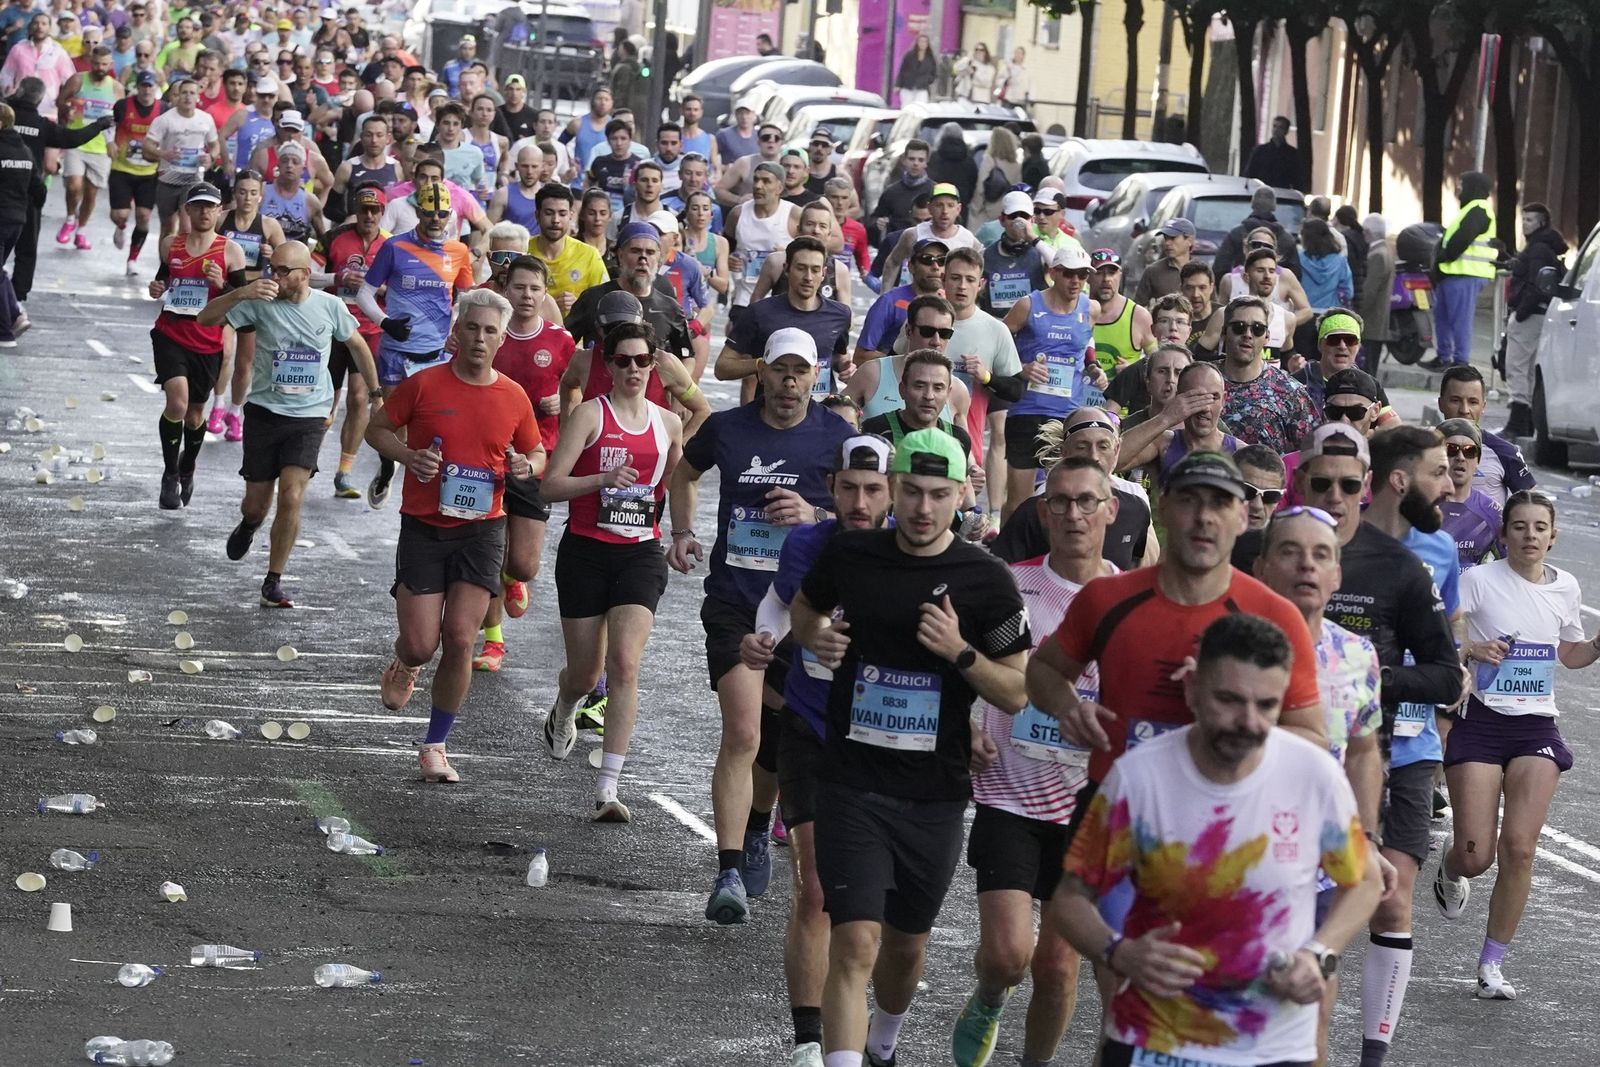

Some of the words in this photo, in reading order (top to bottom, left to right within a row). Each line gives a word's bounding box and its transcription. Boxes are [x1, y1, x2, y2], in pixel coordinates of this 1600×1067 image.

[994, 290, 1028, 300] MOURAD
[170, 297, 203, 306] KRISTOF
[1047, 332, 1072, 340] ITALIA
[1047, 355, 1069, 364] ZURIC
[275, 373, 315, 384] ALBERTO
[600, 446, 628, 458] HYDE
[600, 457, 627, 467] PARK
[461, 468, 490, 480] ZURICH
[738, 475, 798, 486] MICHELIN
[459, 484, 477, 494] 5787
[453, 494, 476, 508] EDD
[621, 501, 639, 510] 4966
[610, 510, 646, 525] HONOR
[750, 528, 770, 539] 6939
[727, 543, 759, 556] SIEMPRE
[1331, 593, 1375, 604] aratona
[1335, 602, 1365, 615] Porto
[1340, 615, 1372, 628] 2025
[1512, 648, 1549, 657] ZURICH
[1513, 667, 1532, 676] 7994
[883, 673, 932, 687] ZURICH
[1496, 678, 1545, 693] LOANNE
[882, 695, 908, 709] 6838
[851, 707, 883, 726] IVAN
[886, 713, 938, 732] DURÁN
[1384, 960, 1400, 1021] COMPRESSPORT
